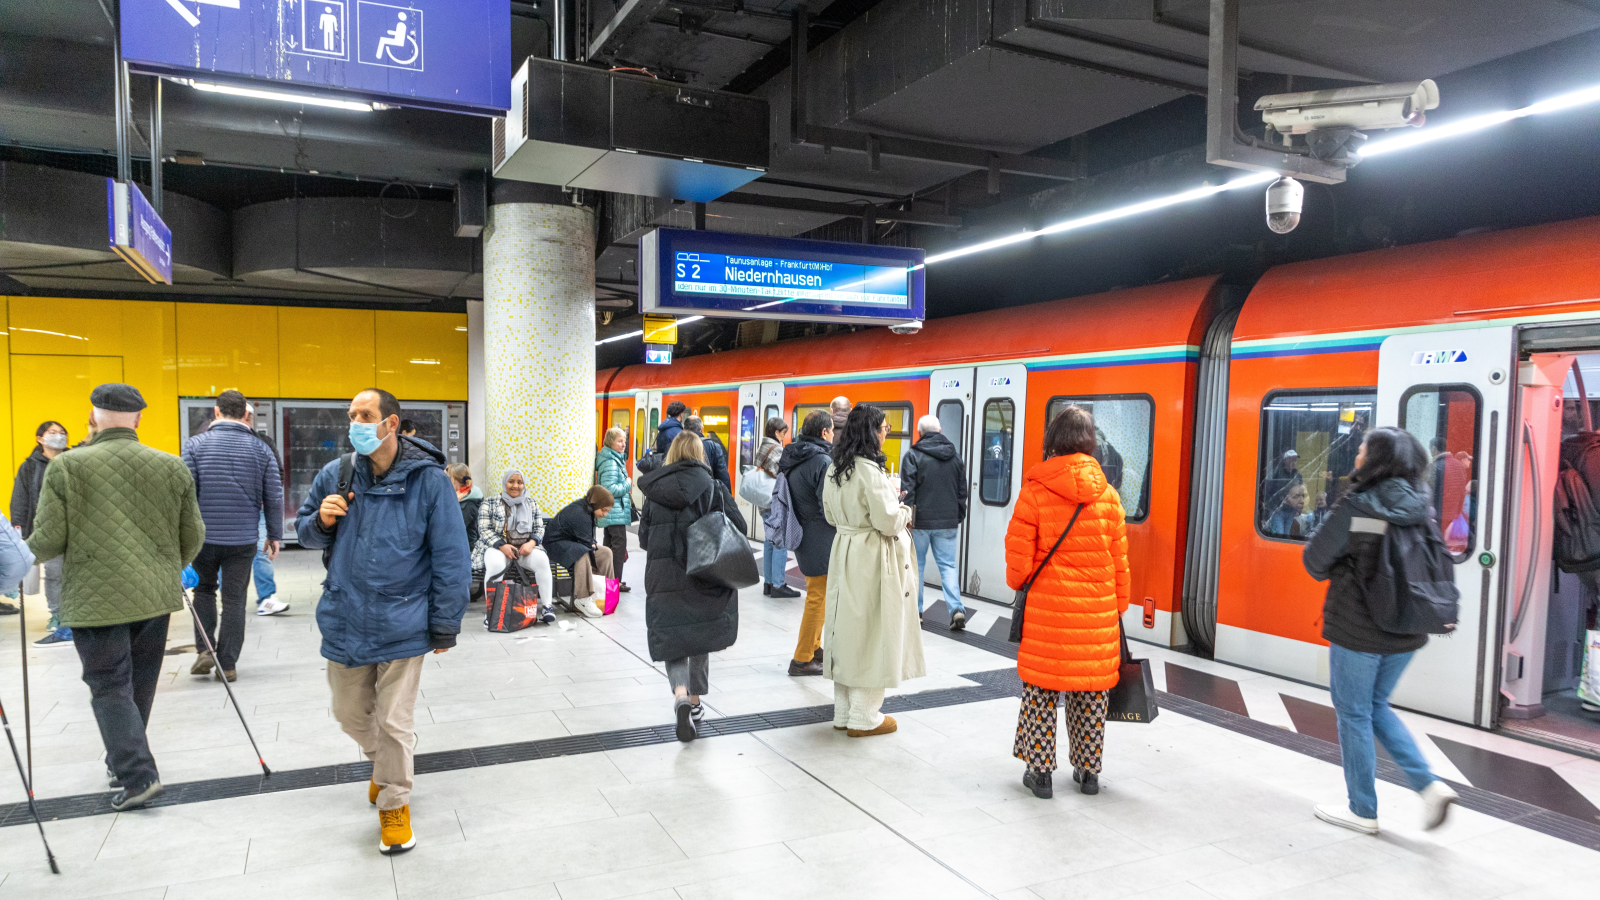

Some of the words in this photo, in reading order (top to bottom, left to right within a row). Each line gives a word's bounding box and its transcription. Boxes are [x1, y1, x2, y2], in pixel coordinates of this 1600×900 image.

[725, 255, 773, 268] Taunusanlage
[676, 263, 686, 278] S
[691, 264, 701, 279] 2
[725, 266, 822, 287] Niedernhausen
[694, 283, 706, 291] nur
